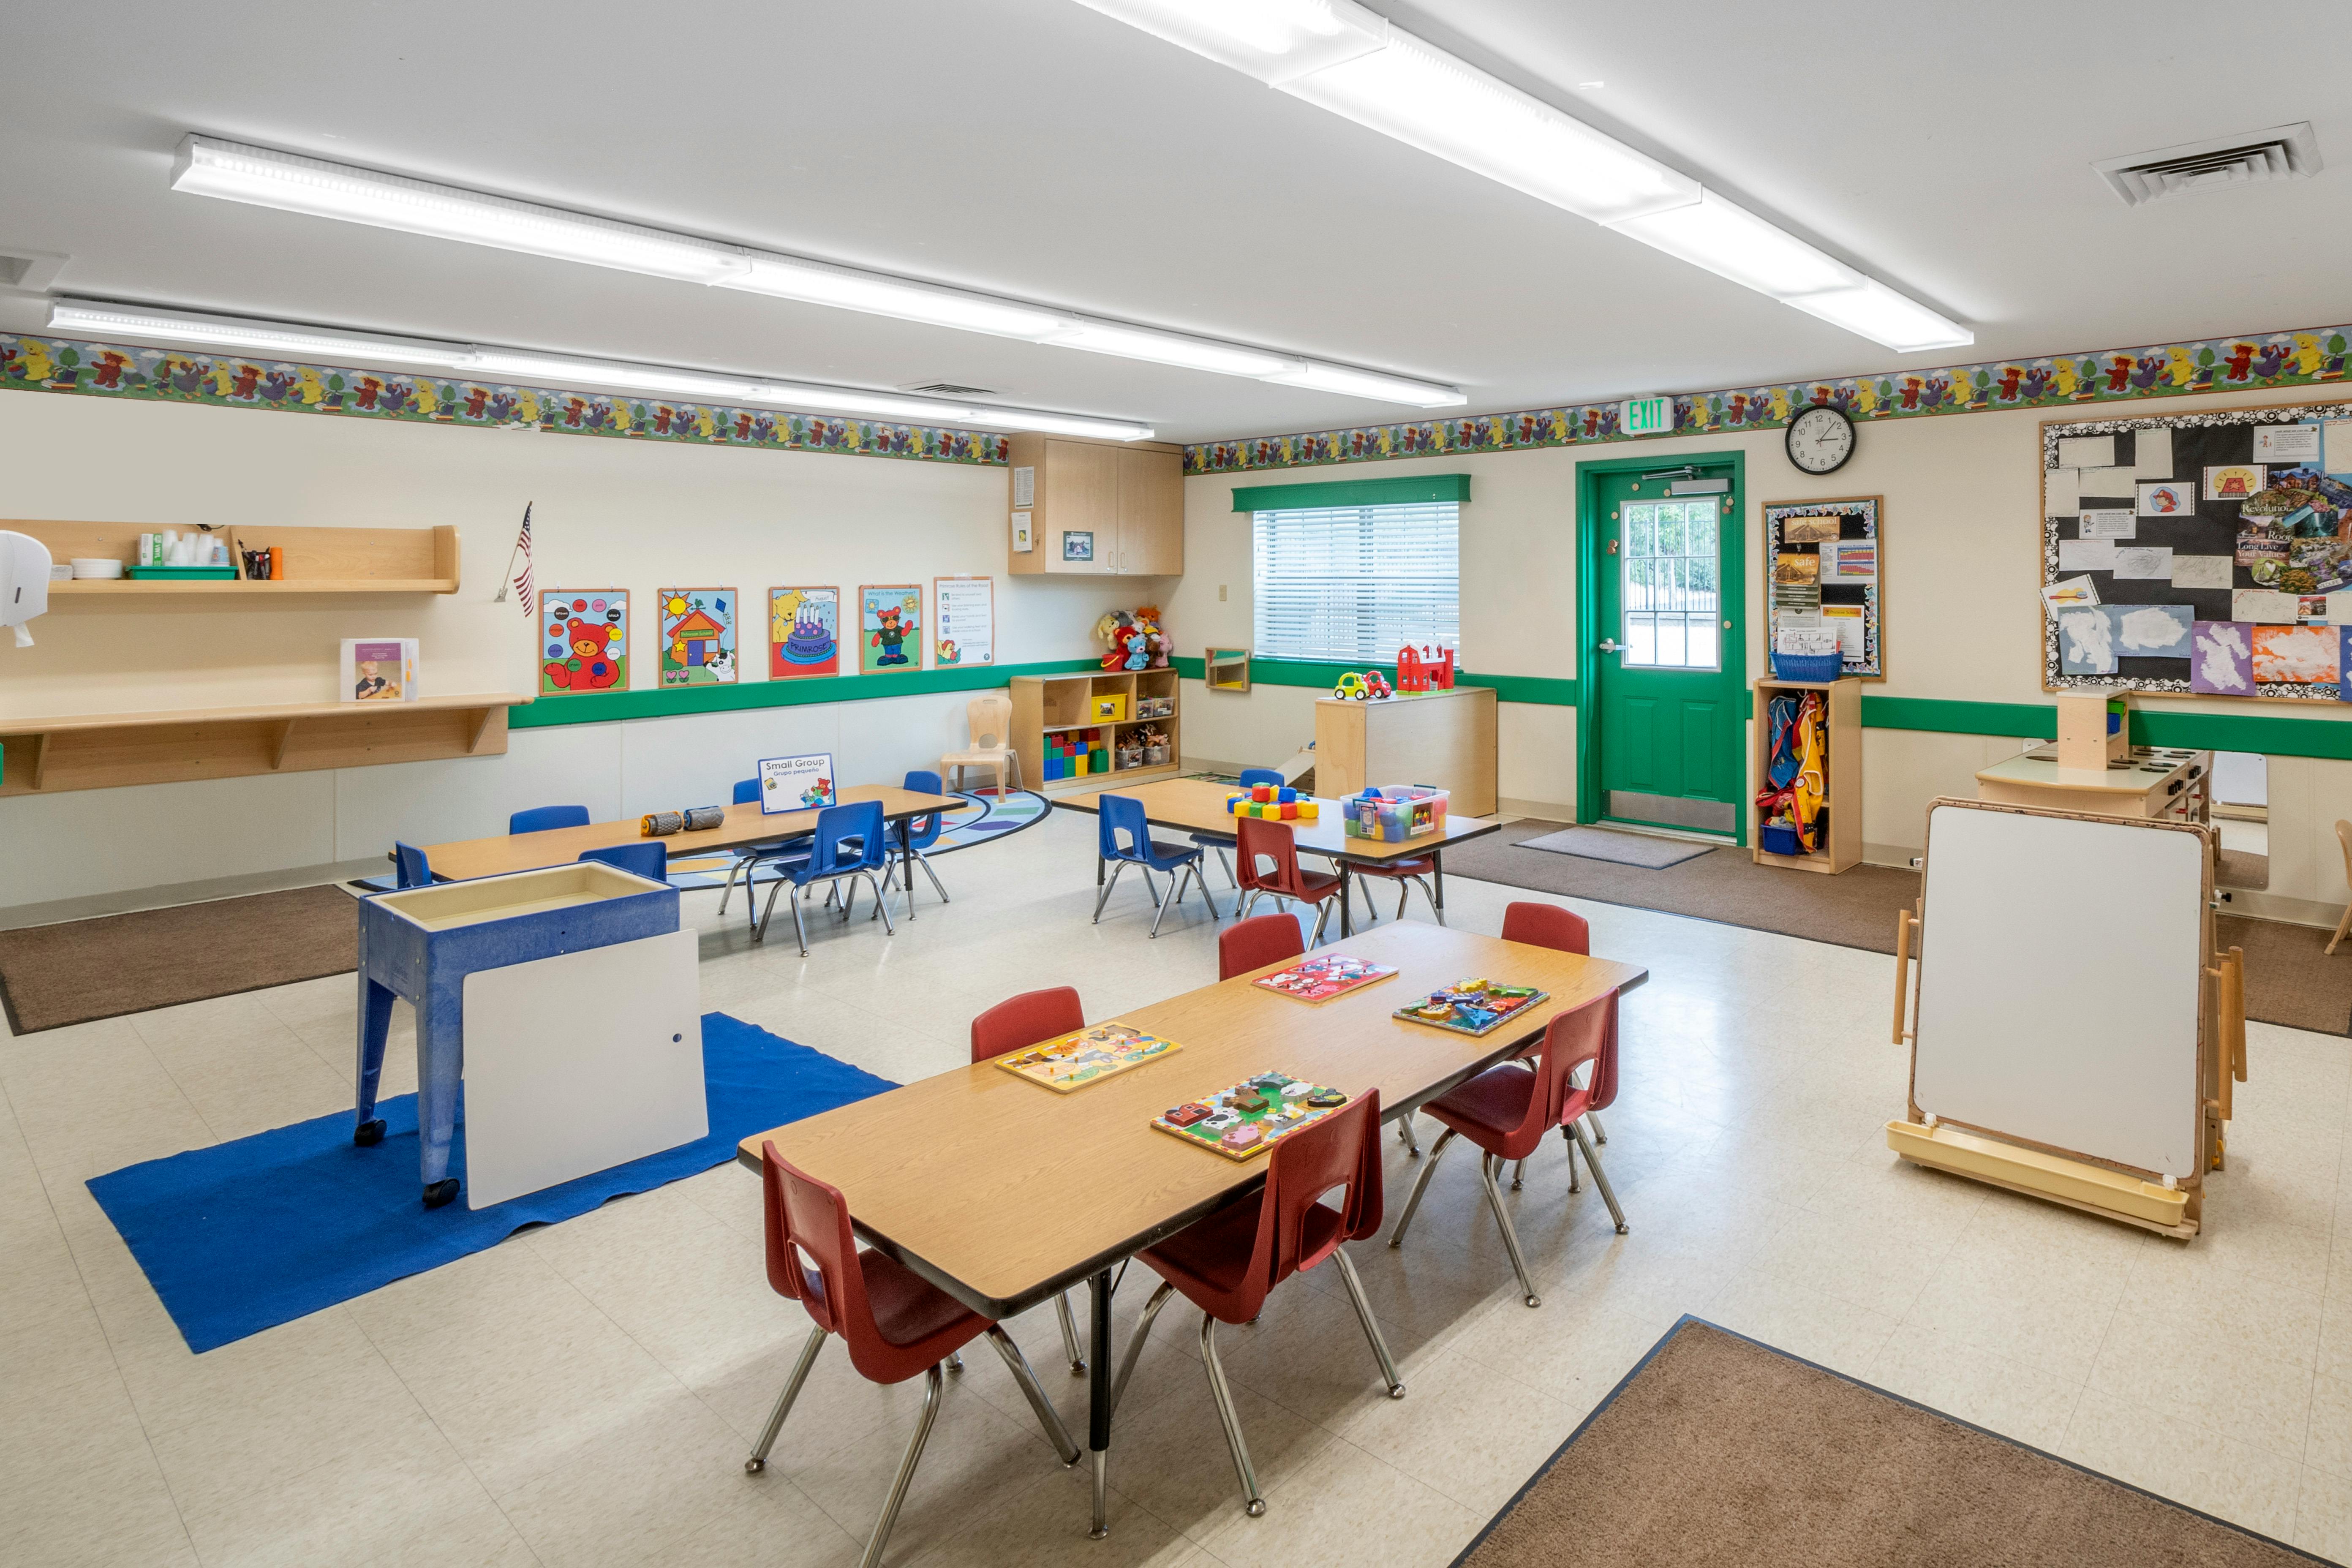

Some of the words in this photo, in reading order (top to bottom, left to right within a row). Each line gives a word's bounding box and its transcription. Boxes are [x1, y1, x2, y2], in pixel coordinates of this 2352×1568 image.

[1629, 399, 1663, 430] EXIT
[1809, 517, 1837, 525] school
[1794, 557, 1815, 566] safe
[791, 642, 828, 653] PRIMROSE
[766, 760, 792, 770] Small
